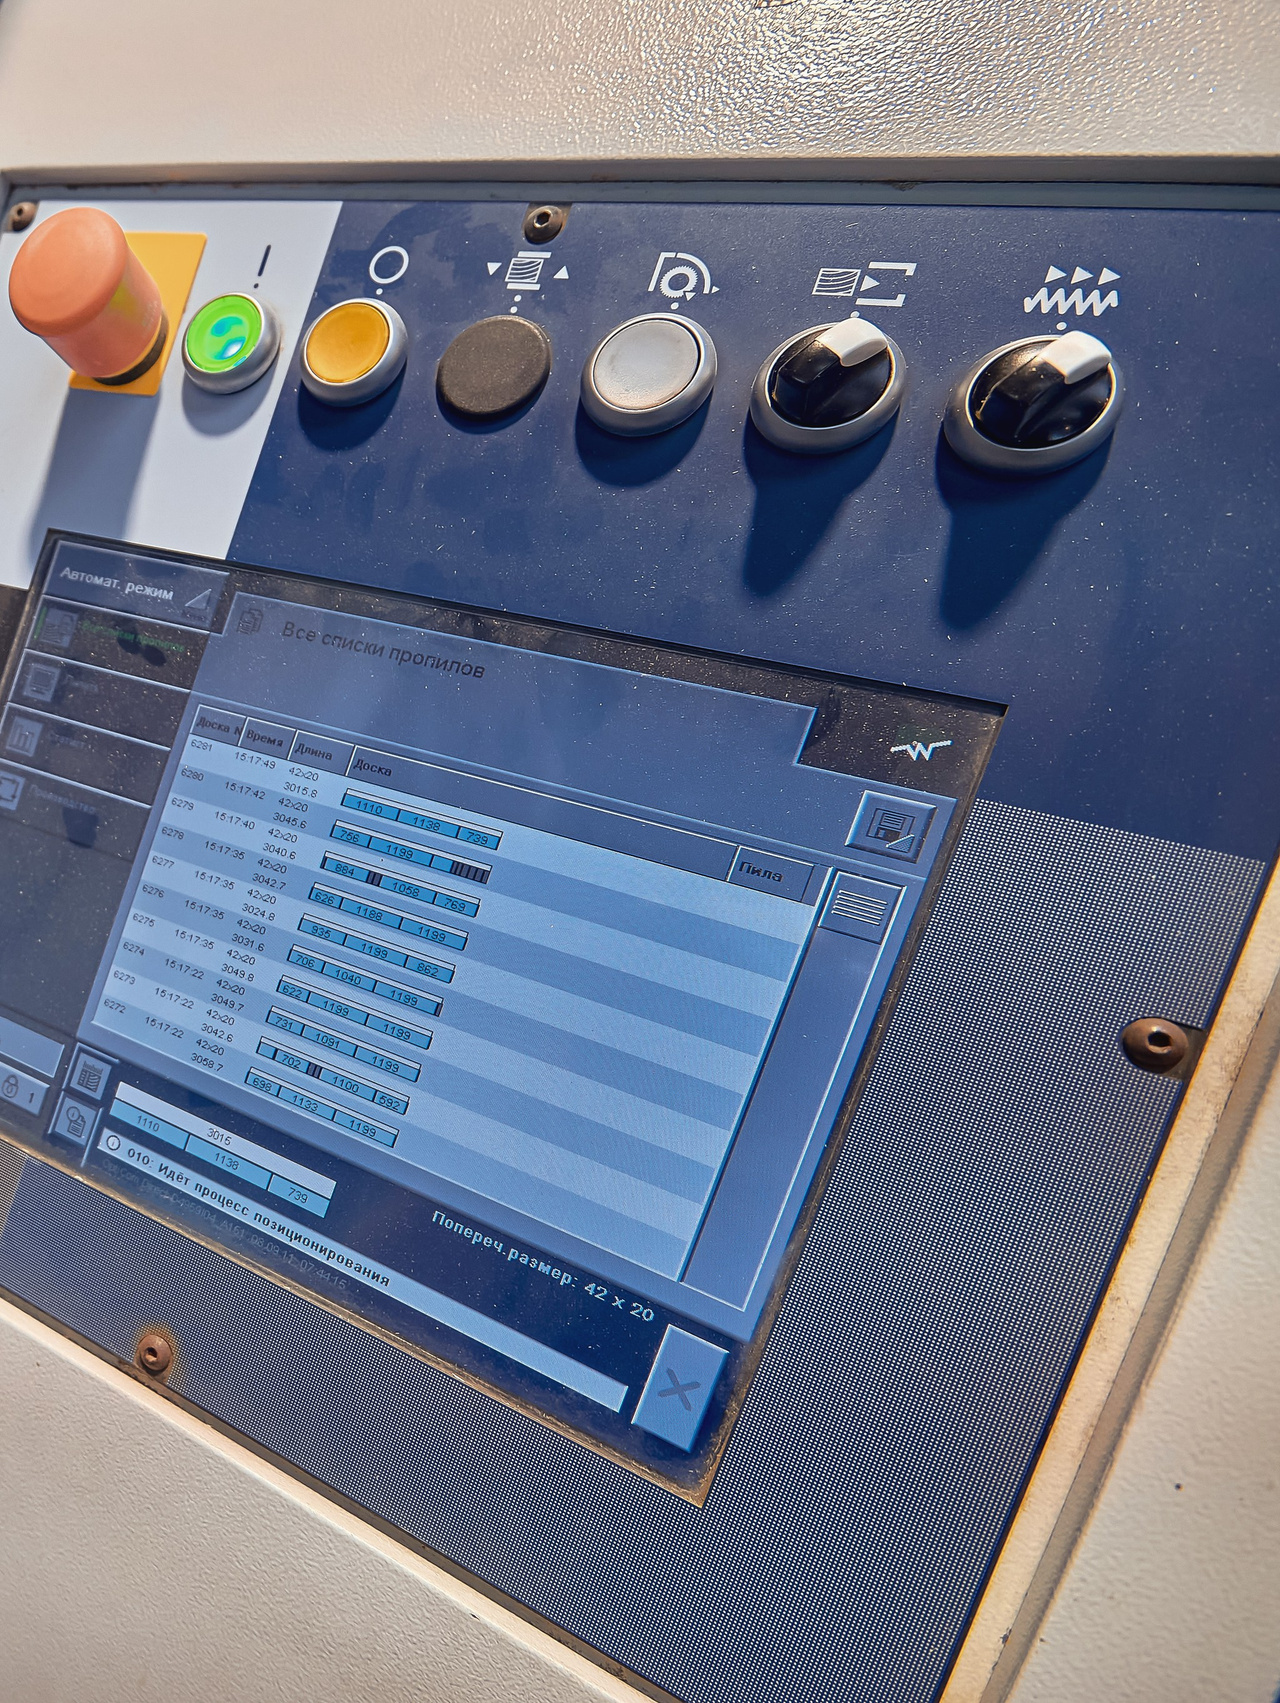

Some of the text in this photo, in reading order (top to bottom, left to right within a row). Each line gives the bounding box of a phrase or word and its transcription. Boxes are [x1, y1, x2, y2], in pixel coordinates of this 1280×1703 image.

[60, 567, 174, 600] Автомат. режим
[283, 620, 486, 679] Все списки пропилов
[196, 716, 230, 733] Доска
[246, 730, 284, 747] Время
[191, 739, 319, 782] 6281 15:17:49 42x20
[294, 743, 333, 760] Длина
[353, 758, 392, 776] Доска
[181, 768, 308, 812] 6280 15:17:42 42x20
[284, 782, 318, 798] 3015.8
[172, 798, 298, 844] 6279 15:17:40 42x20
[272, 812, 308, 830] 3045.6
[356, 800, 488, 846] 1110 1138 739
[161, 826, 287, 874] 6278 15:17:35 42x20
[263, 842, 296, 860] 3040.6
[341, 830, 414, 860] 756 1199
[152, 855, 276, 904] 6277 15:17:35 42x20
[252, 872, 286, 890] 3042.7
[335, 863, 466, 912] 884 1058 769
[738, 860, 783, 883] Пила
[142, 884, 266, 935] 6276 15:17:35 42x20
[242, 903, 276, 921] 3024.8
[314, 892, 446, 942] 626 1188 1199
[132, 912, 256, 965] 6275 15:17:35 42x20
[232, 933, 265, 952] 3031.6
[312, 925, 439, 978] 935 1199 862
[122, 942, 246, 996] 6274 15:17:22 42x20
[222, 963, 254, 982] 3049.8
[296, 954, 418, 1006] 706 1040 1199
[113, 970, 236, 1026] 6273 15:17:22 42x20
[211, 993, 245, 1012] 3049.7
[282, 984, 410, 1040] 622 1199 1199
[104, 998, 224, 1056] 6272 15:17:22 42x20
[200, 1023, 234, 1042] 3042.6
[276, 1016, 400, 1073] 731 1091 1199
[190, 1052, 224, 1072] 3058.7
[282, 1054, 401, 1111] 702 1100 592
[28, 1092, 35, 1104] 1
[252, 1078, 376, 1137] 698 1133 1199
[207, 1128, 232, 1146] 3015
[136, 1115, 308, 1204] 1110 1138 739
[128, 1148, 391, 1288] 010: Идёт процесс позиционирования
[584, 1282, 608, 1302] 42
[630, 1302, 655, 1322] 20
